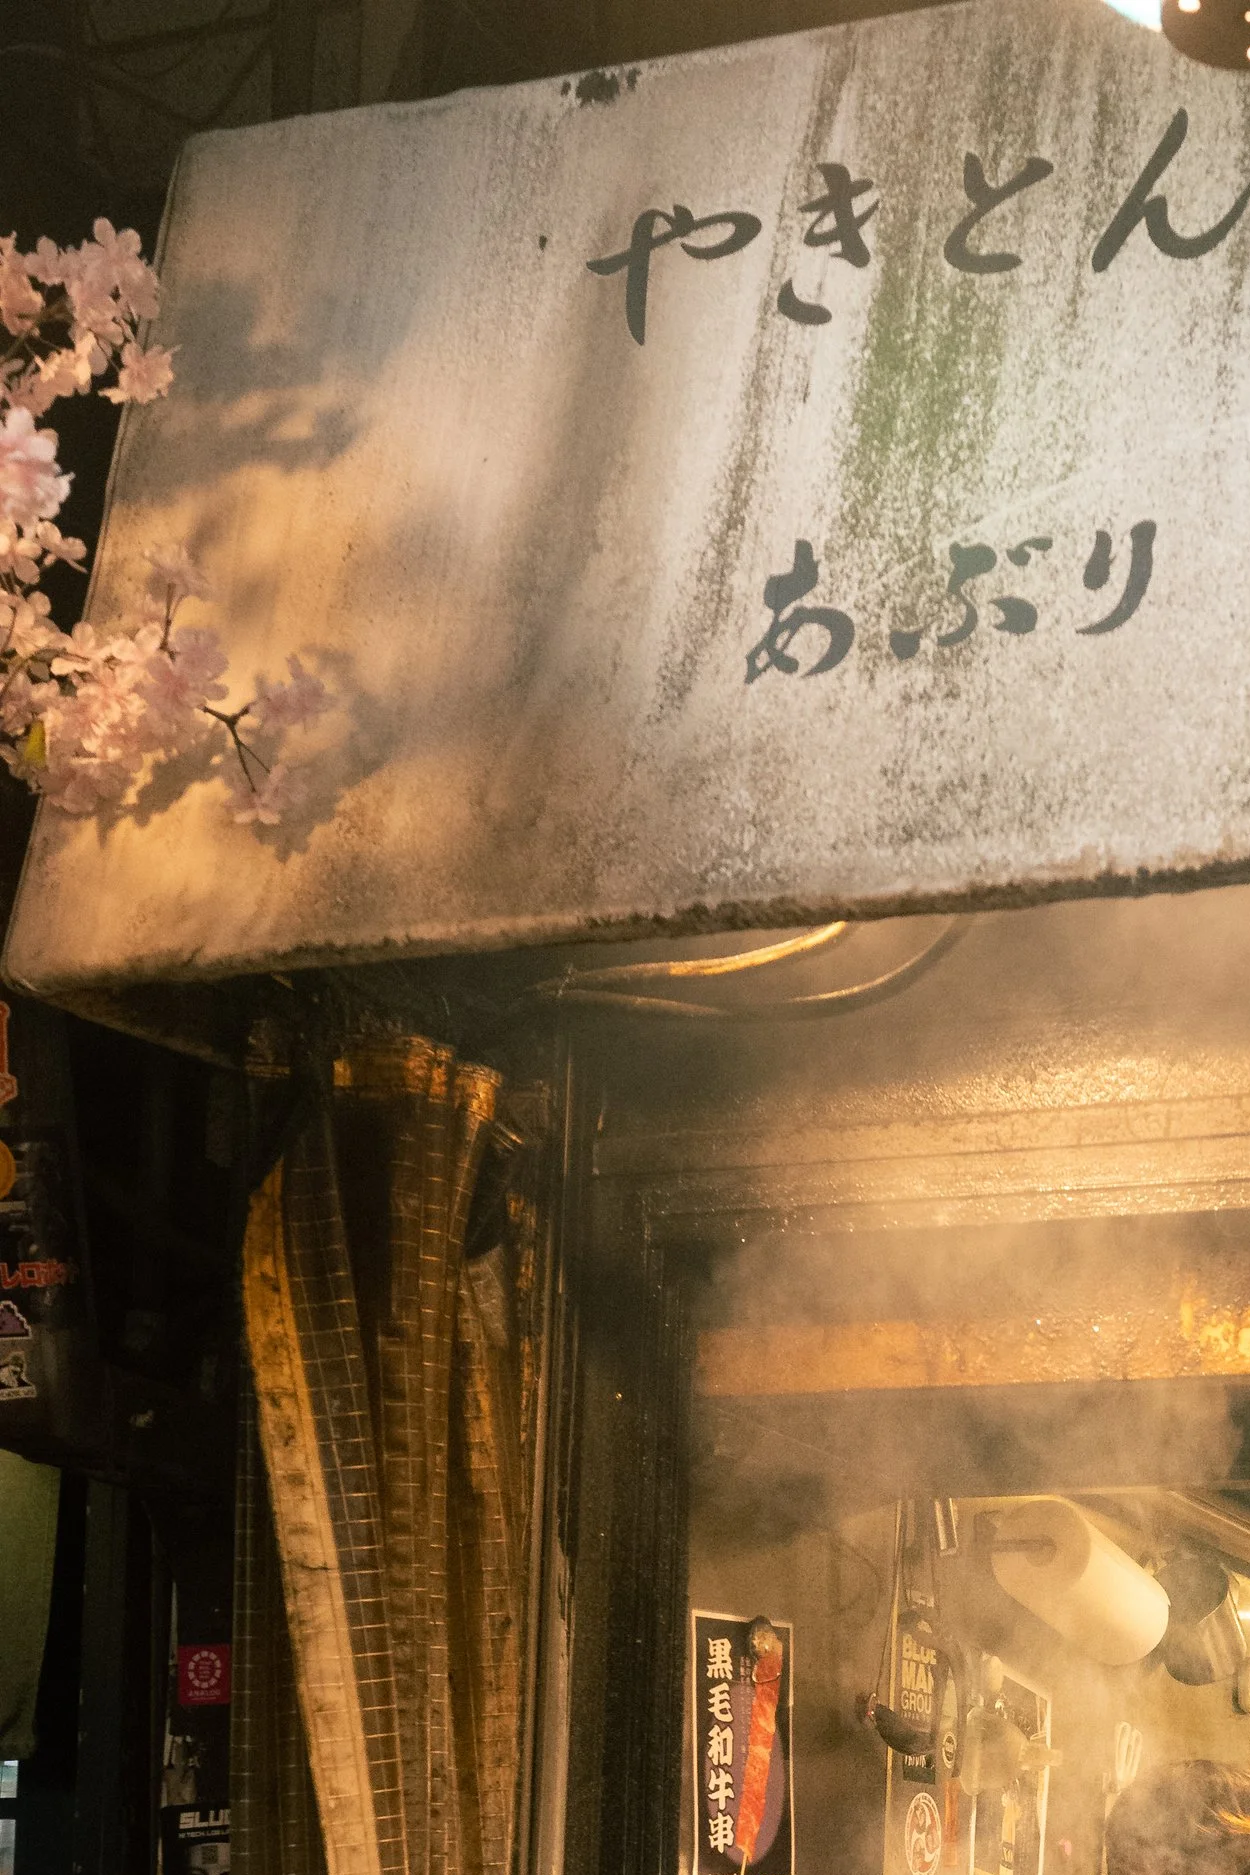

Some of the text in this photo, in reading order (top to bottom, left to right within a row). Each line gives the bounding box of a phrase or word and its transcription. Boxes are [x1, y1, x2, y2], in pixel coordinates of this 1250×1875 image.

[743, 519, 1159, 685] あぶり
[706, 1637, 735, 1855] 黒毛和牛串
